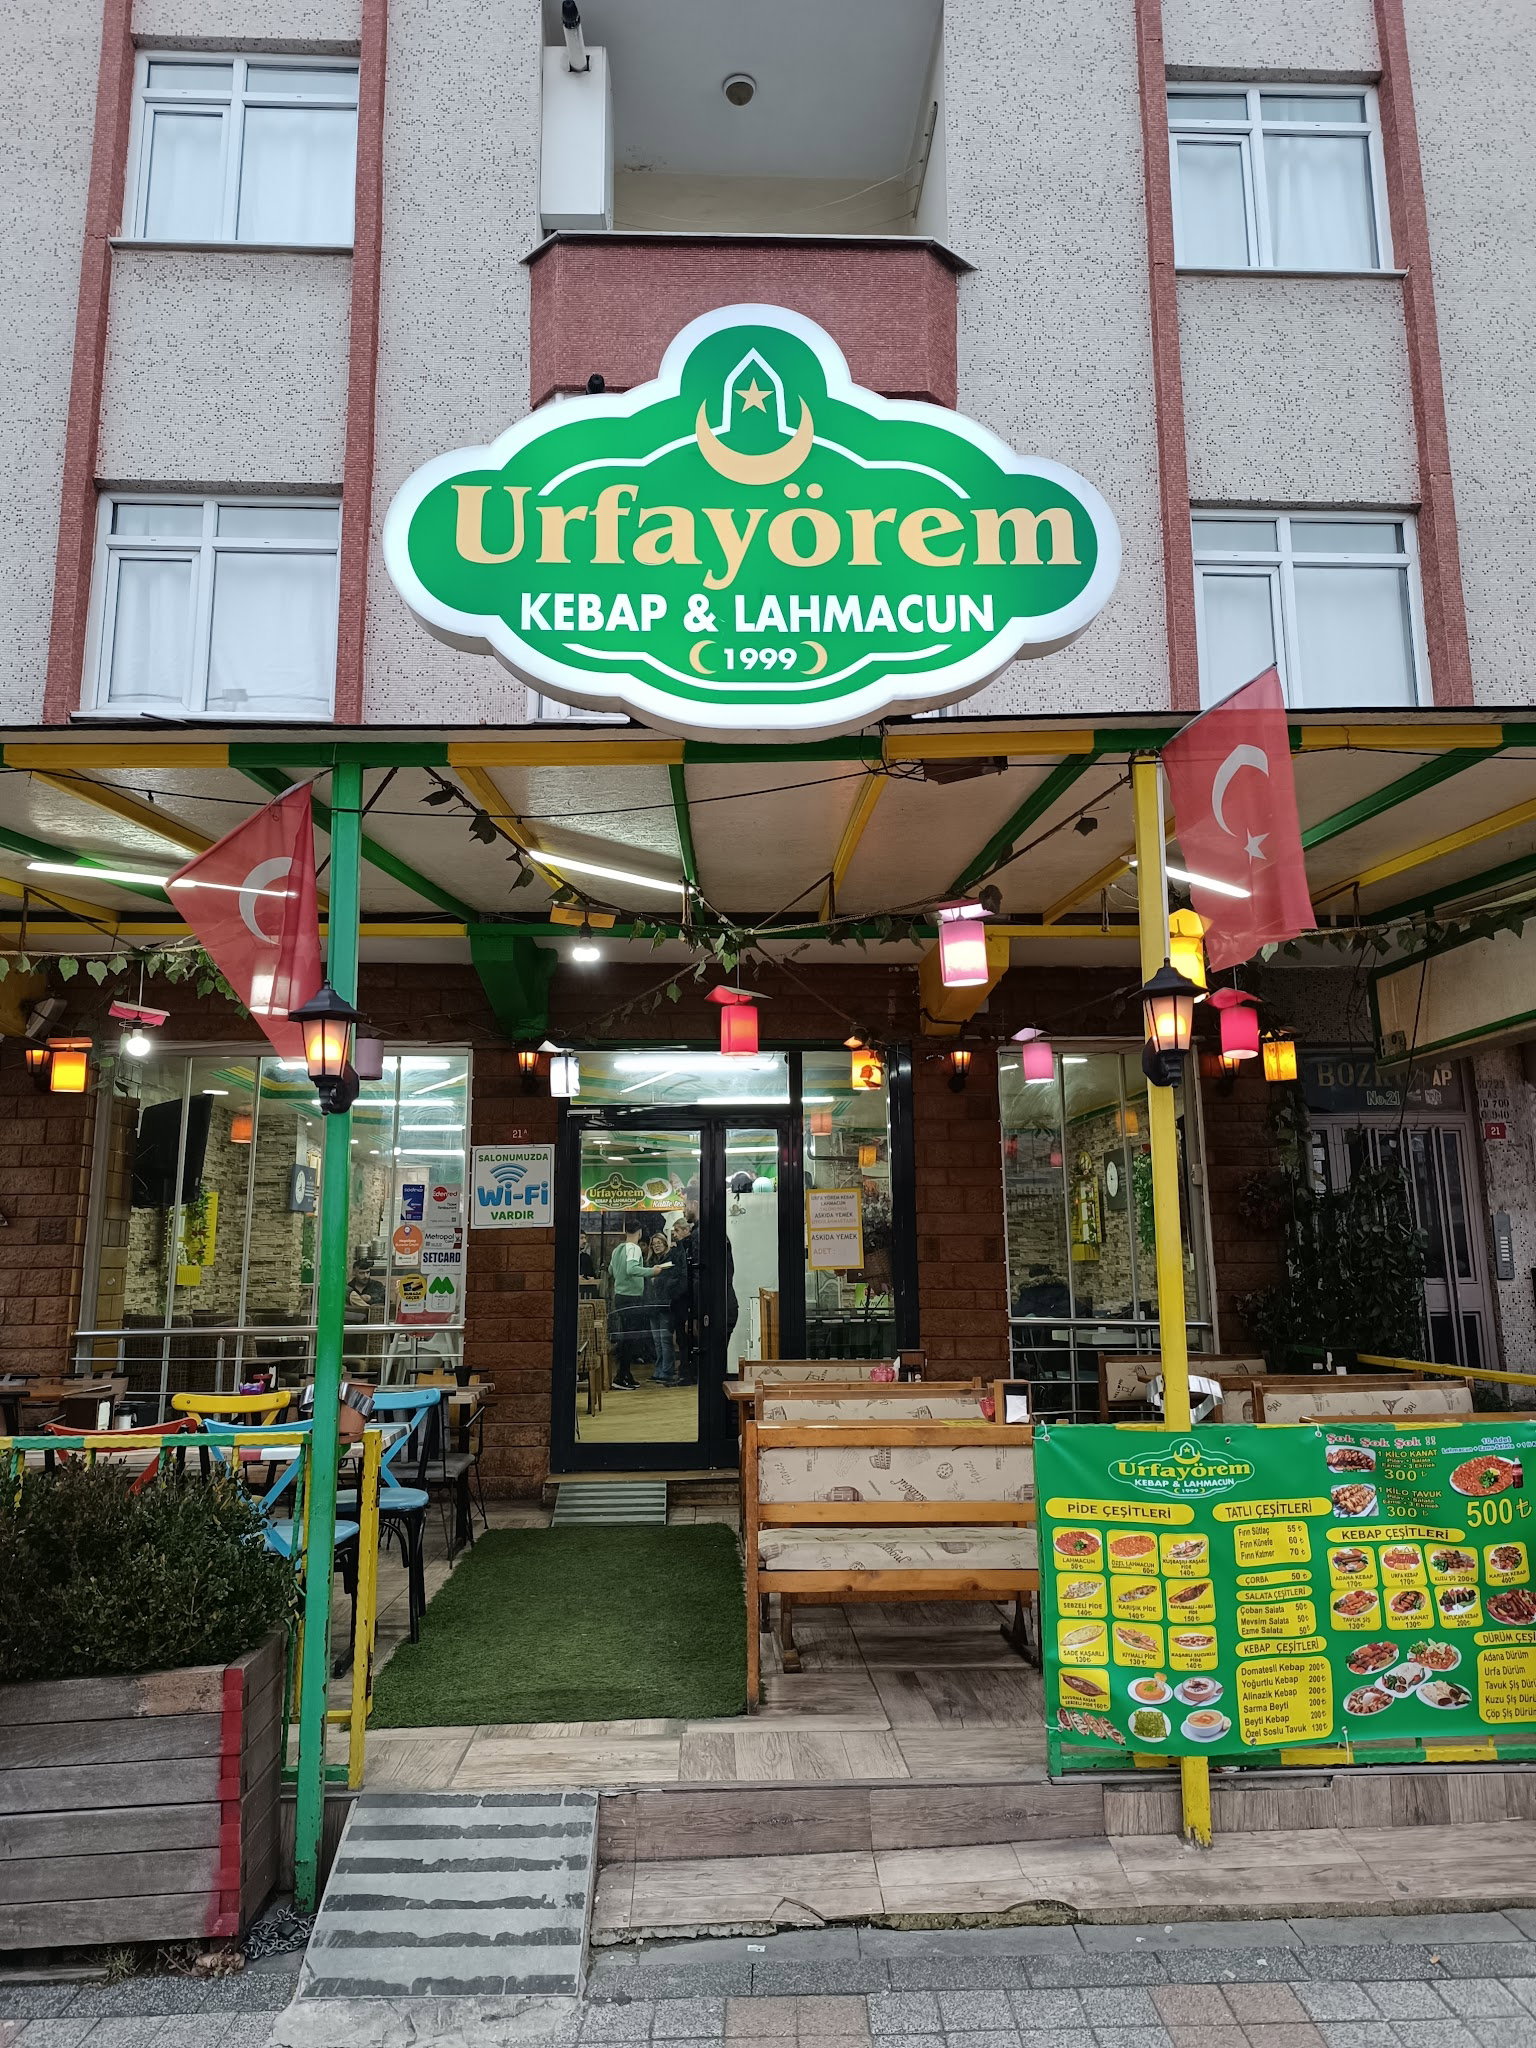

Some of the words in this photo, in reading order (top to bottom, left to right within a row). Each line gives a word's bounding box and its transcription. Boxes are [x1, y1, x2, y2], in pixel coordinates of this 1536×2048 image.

[452, 483, 1082, 591] Urfayörem
[520, 594, 667, 633] KEBAP
[683, 594, 717, 633] &
[734, 595, 995, 633] LAHMACUN
[723, 647, 797, 672] 1999
[1490, 1126, 1501, 1136] 21
[478, 1153, 549, 1162] SALONUMUZDA
[477, 1180, 549, 1207] Wi-Fi
[490, 1210, 534, 1220] VARDIR
[425, 1233, 455, 1241] Metropol
[423, 1252, 461, 1263] SETCARD
[1385, 1450, 1407, 1458] KİLO
[1410, 1449, 1438, 1457] KANAT
[1118, 1462, 1250, 1480] Urfayörem
[1384, 1469, 1417, 1481] 300
[1135, 1479, 1169, 1488] KEBAP
[1173, 1480, 1180, 1488] &
[1184, 1478, 1235, 1488] LAHMACUN
[1386, 1487, 1408, 1496] KİLO
[1067, 1502, 1098, 1514] PİDE
[1103, 1504, 1171, 1519] ÇEŞİTLERİ
[1225, 1505, 1252, 1518] TATLI
[1255, 1499, 1312, 1518] ÇEŞİTLERİ
[1387, 1506, 1417, 1518] 300
[1467, 1498, 1513, 1528] 500
[1341, 1529, 1382, 1540] KEBAP
[1385, 1525, 1449, 1540] ÇEŞİTLERİ
[1245, 1575, 1269, 1585] ÇORBA
[1245, 1591, 1272, 1600] SALATA
[1264, 1605, 1285, 1614] Salata
[1268, 1617, 1289, 1625] Salata
[1261, 1626, 1283, 1634] Salata
[1483, 1631, 1513, 1643] DÜRÜM
[1244, 1642, 1270, 1655] KEBAP
[1276, 1637, 1319, 1654] ÇEŞİTLERİ
[1483, 1652, 1504, 1662] Adana
[1241, 1664, 1277, 1676] Domatesli
[1279, 1663, 1305, 1673] Kebap
[1484, 1666, 1501, 1676] Urfa
[1502, 1665, 1526, 1675] Dürüm
[1242, 1677, 1273, 1690] Yoğurtlu
[1274, 1676, 1299, 1686] Kebap
[1485, 1681, 1507, 1690] Tavuk
[1274, 1688, 1298, 1698] Kebap
[1485, 1695, 1504, 1704] Kuzu
[1243, 1704, 1268, 1714] Sarma
[1485, 1709, 1500, 1720] Çöp
[1265, 1715, 1290, 1724] Kebap
[1245, 1727, 1261, 1738] Özel
[1263, 1726, 1284, 1736] Soslu
[1285, 1724, 1307, 1734] Tavuk
